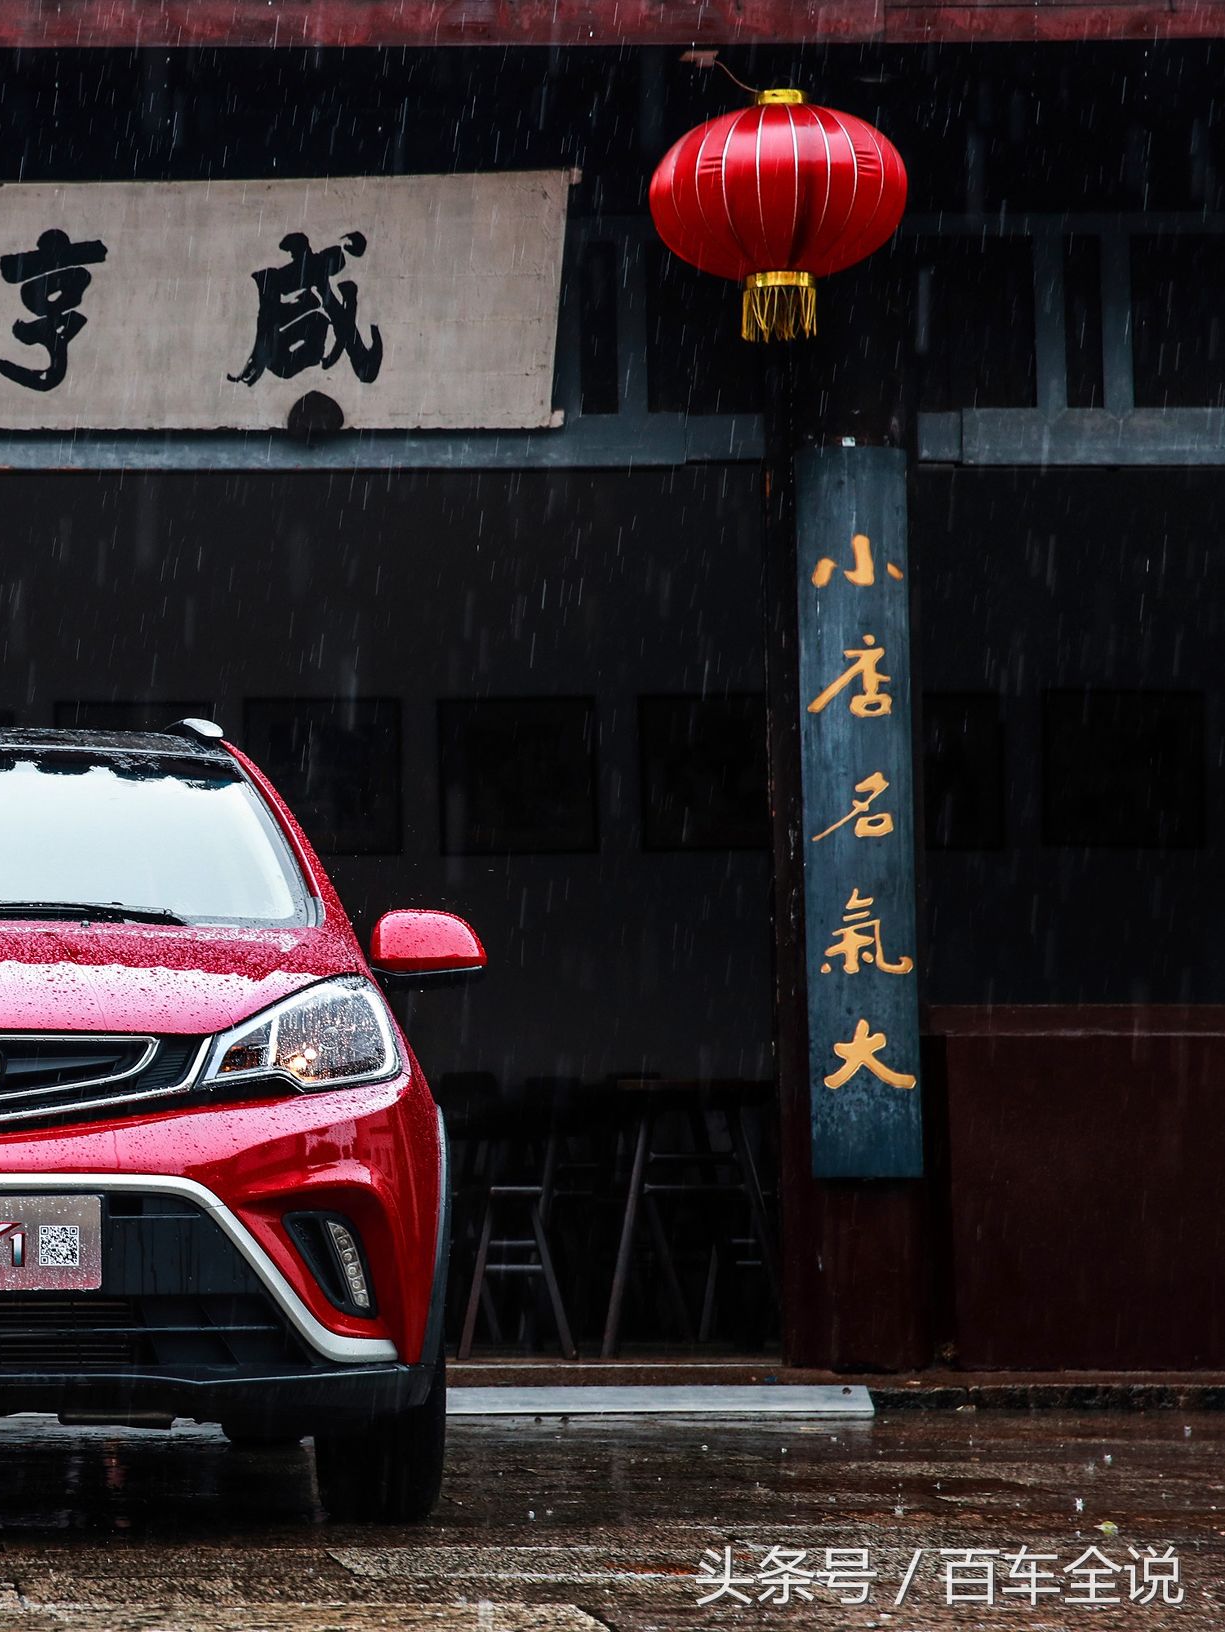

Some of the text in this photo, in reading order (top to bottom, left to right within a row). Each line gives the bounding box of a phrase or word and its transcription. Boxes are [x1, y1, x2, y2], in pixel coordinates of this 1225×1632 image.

[807, 534, 917, 1090] 小店名氣大
